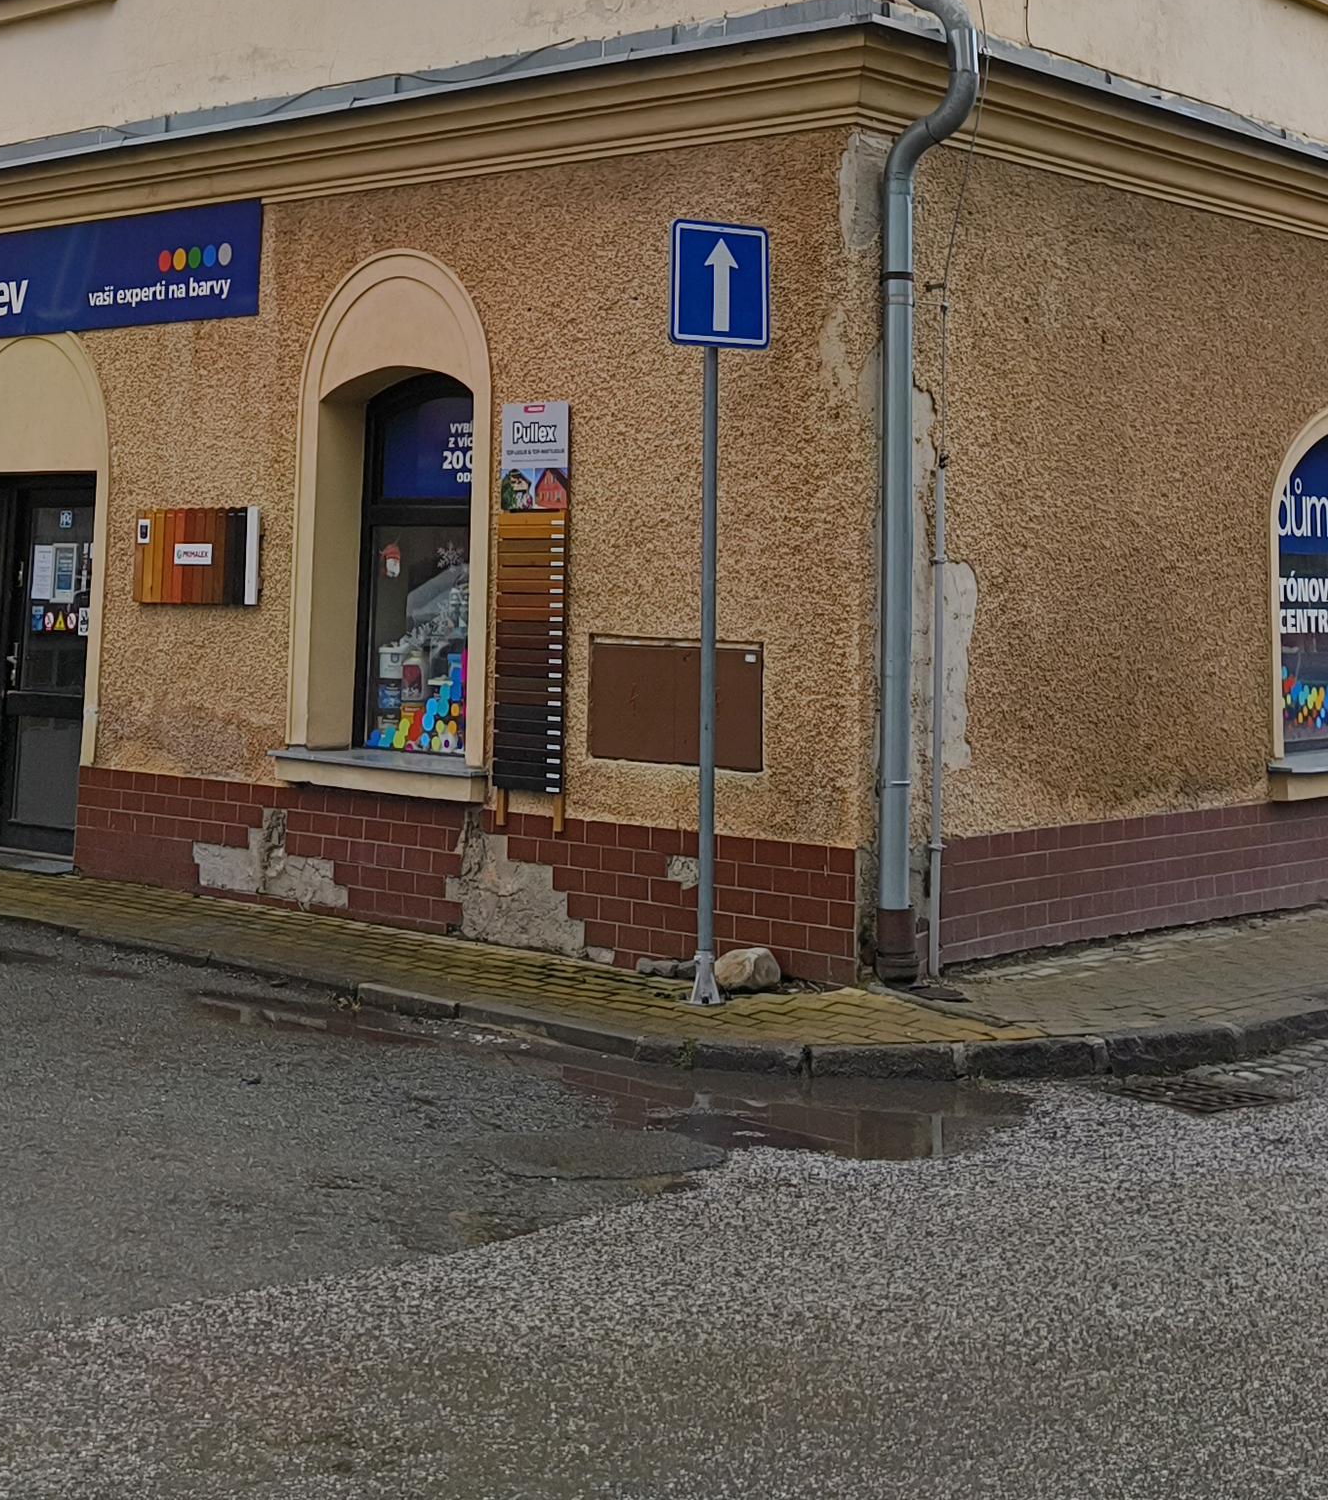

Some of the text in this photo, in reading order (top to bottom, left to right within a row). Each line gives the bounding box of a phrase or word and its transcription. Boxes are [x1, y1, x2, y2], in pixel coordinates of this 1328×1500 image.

[88, 277, 231, 307] vaši experti na barvy
[513, 420, 557, 444] Pullex
[448, 437, 455, 448] Z
[456, 472, 473, 483] OD
